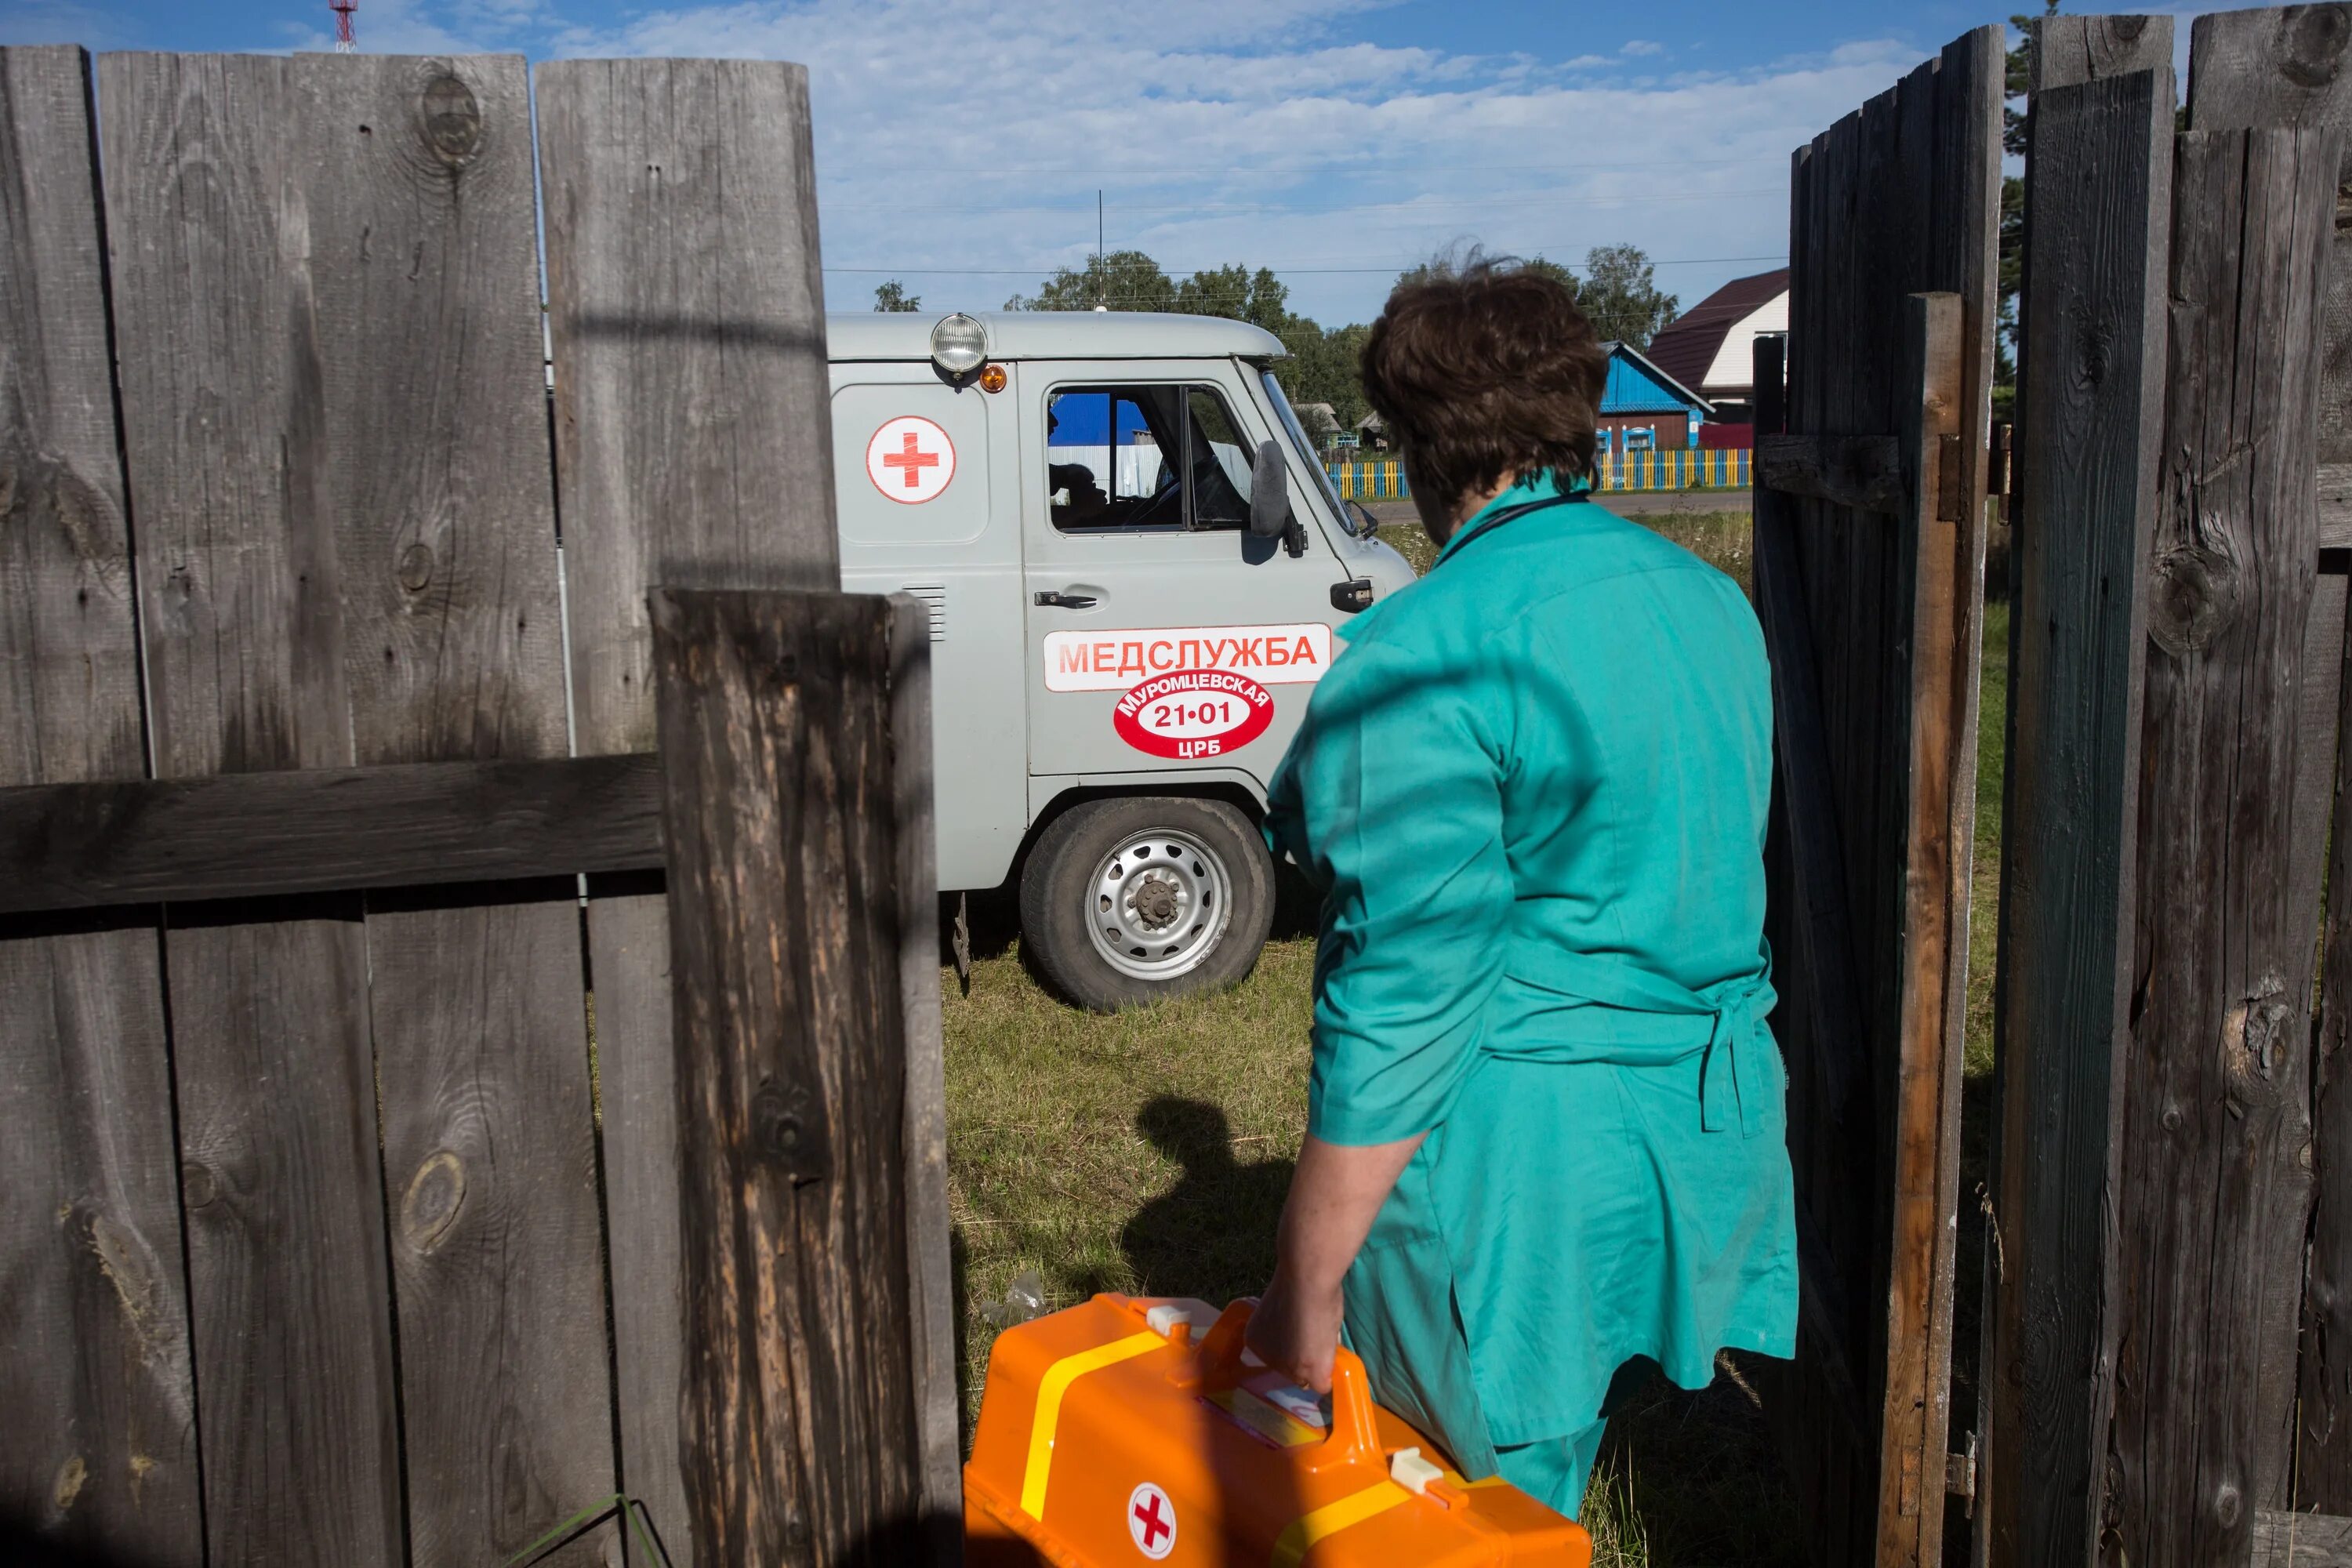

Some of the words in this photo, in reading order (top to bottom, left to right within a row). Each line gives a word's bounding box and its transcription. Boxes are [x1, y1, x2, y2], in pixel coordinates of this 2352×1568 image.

[1059, 636, 1317, 677] МЕДСЛУЖБА
[1117, 673, 1270, 718] МУРОМЦЕВСКАЯ
[1178, 739, 1221, 758] ЦРБ
